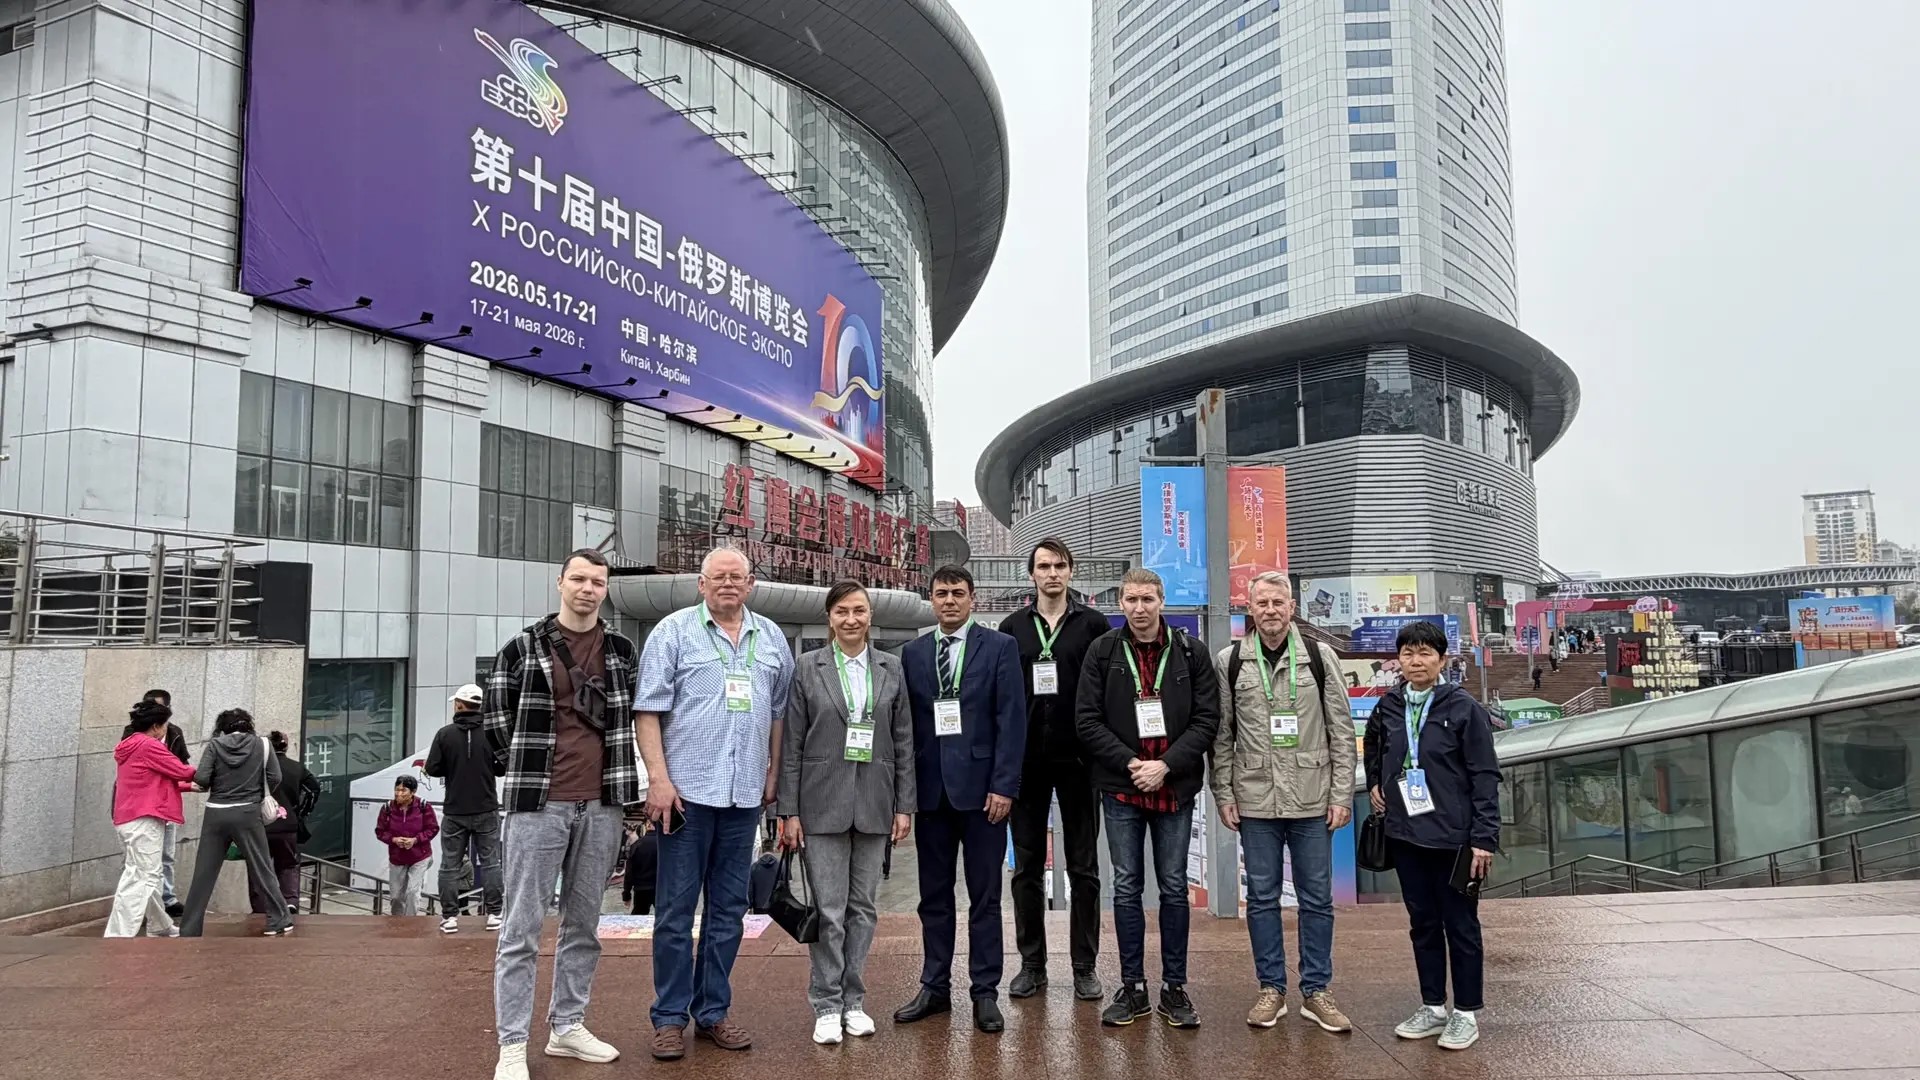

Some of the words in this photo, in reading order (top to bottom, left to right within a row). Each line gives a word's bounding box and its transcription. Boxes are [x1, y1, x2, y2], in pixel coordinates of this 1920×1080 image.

[481, 79, 544, 128] EXPO
[470, 127, 809, 348] 第十届中国-俄罗斯博览会
[470, 261, 597, 325] 2026.05.17-21
[501, 211, 748, 347] РОССИЙСКО-КИТАЙСКОЕ
[751, 332, 793, 368] ЭКСПО
[470, 298, 511, 326] 17-21
[514, 316, 542, 334] мая
[545, 322, 576, 346] 2026
[578, 335, 586, 350] г.
[620, 347, 654, 375] Китай,
[656, 360, 691, 386] Харбин
